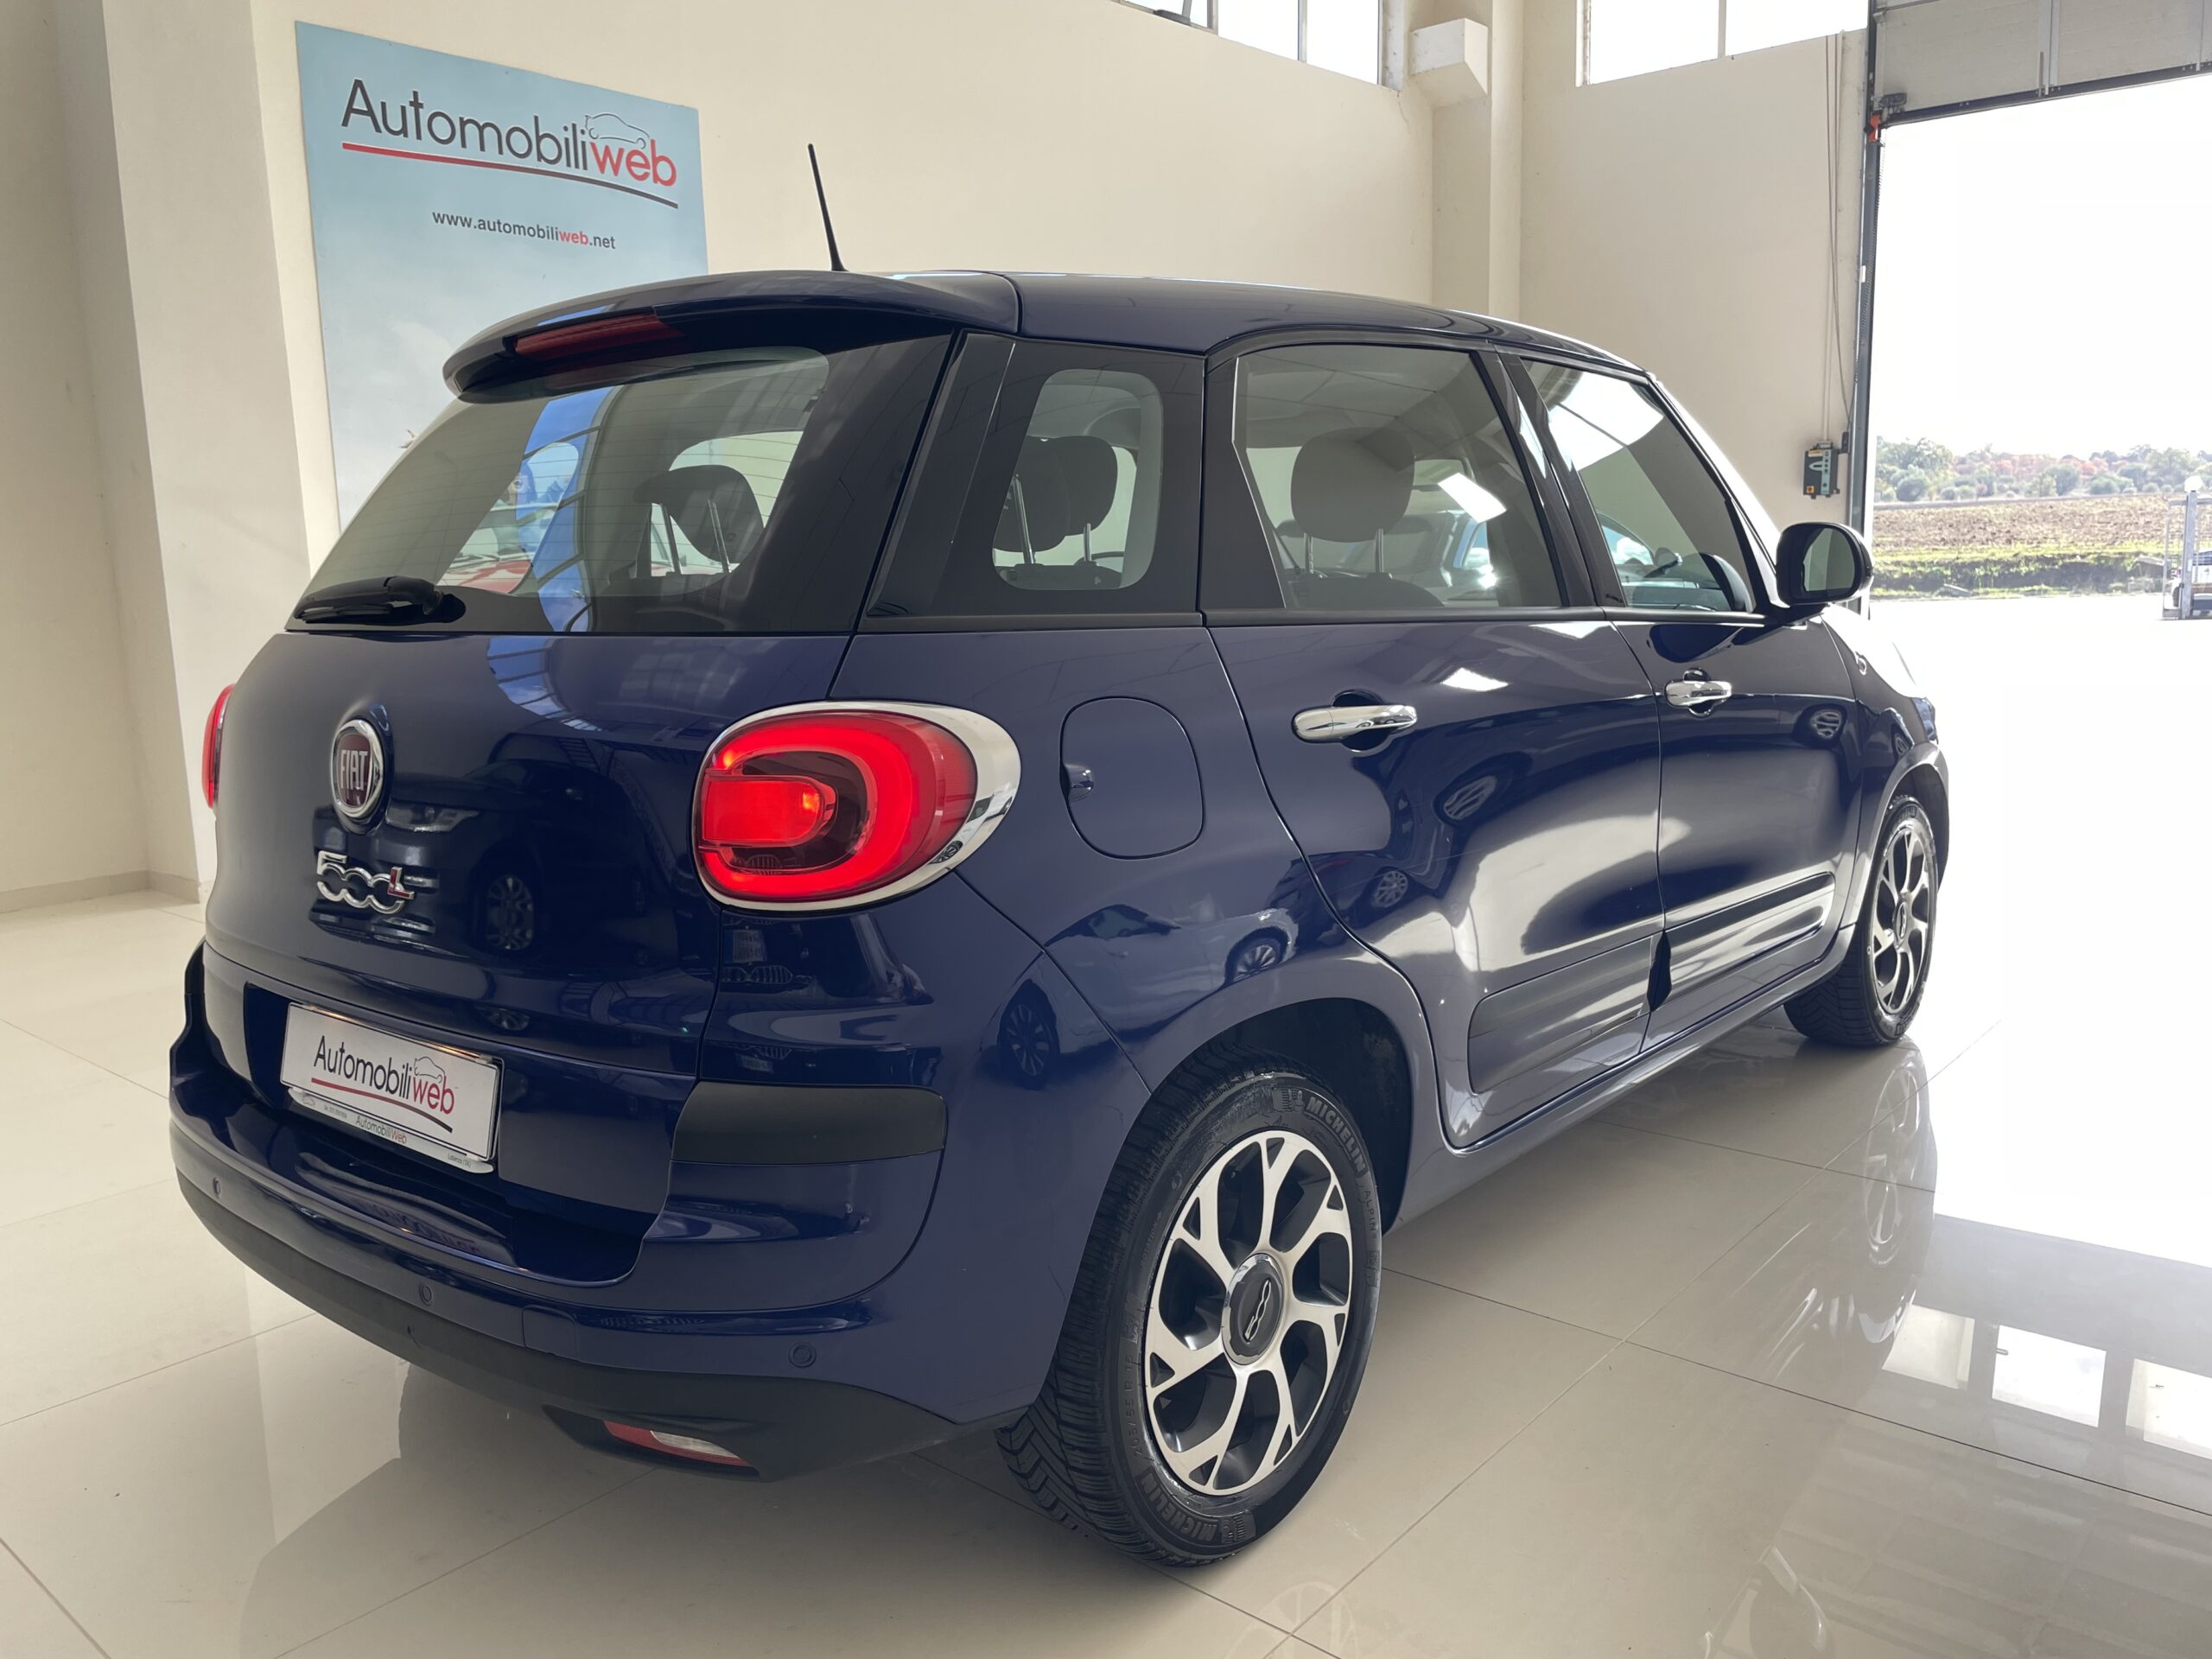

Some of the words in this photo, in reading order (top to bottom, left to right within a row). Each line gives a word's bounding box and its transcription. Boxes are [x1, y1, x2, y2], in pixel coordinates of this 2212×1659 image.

[341, 79, 677, 187] Automobiliweb
[432, 211, 616, 250] www.automobiliweb.net
[340, 749, 368, 791] FIAT
[316, 849, 415, 914] 500L
[314, 1035, 454, 1115] Automobiliweb
[1306, 1096, 1367, 1174] MICHELIN
[1363, 1190, 1377, 1231] ALPIN
[1140, 1471, 1219, 1541] MICHELIN
